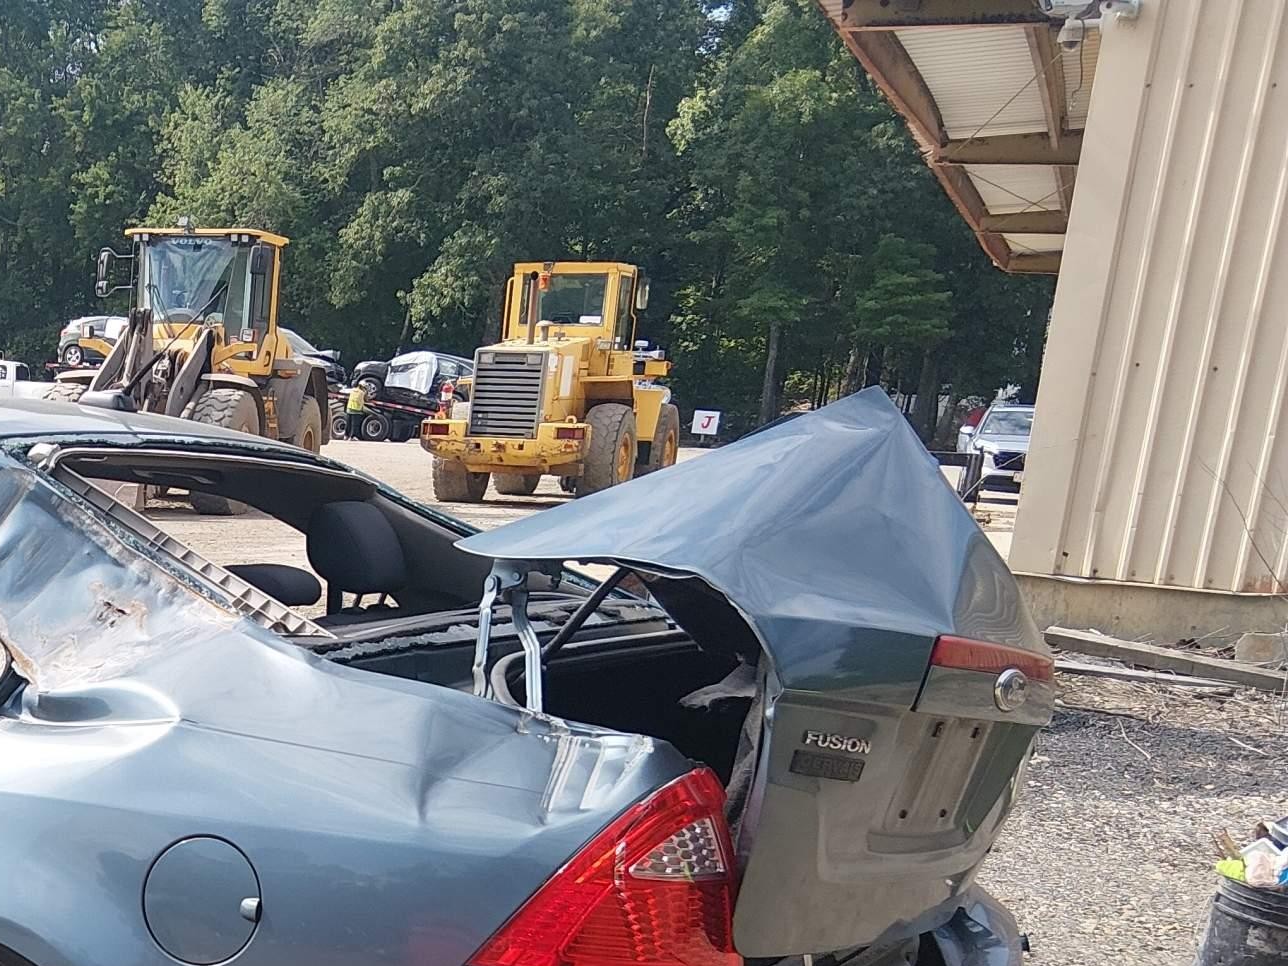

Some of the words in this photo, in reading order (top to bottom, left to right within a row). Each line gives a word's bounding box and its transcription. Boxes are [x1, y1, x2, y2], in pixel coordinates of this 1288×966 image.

[170, 237, 213, 246] VOLVO
[700, 415, 716, 429] J
[804, 730, 873, 754] FUSION
